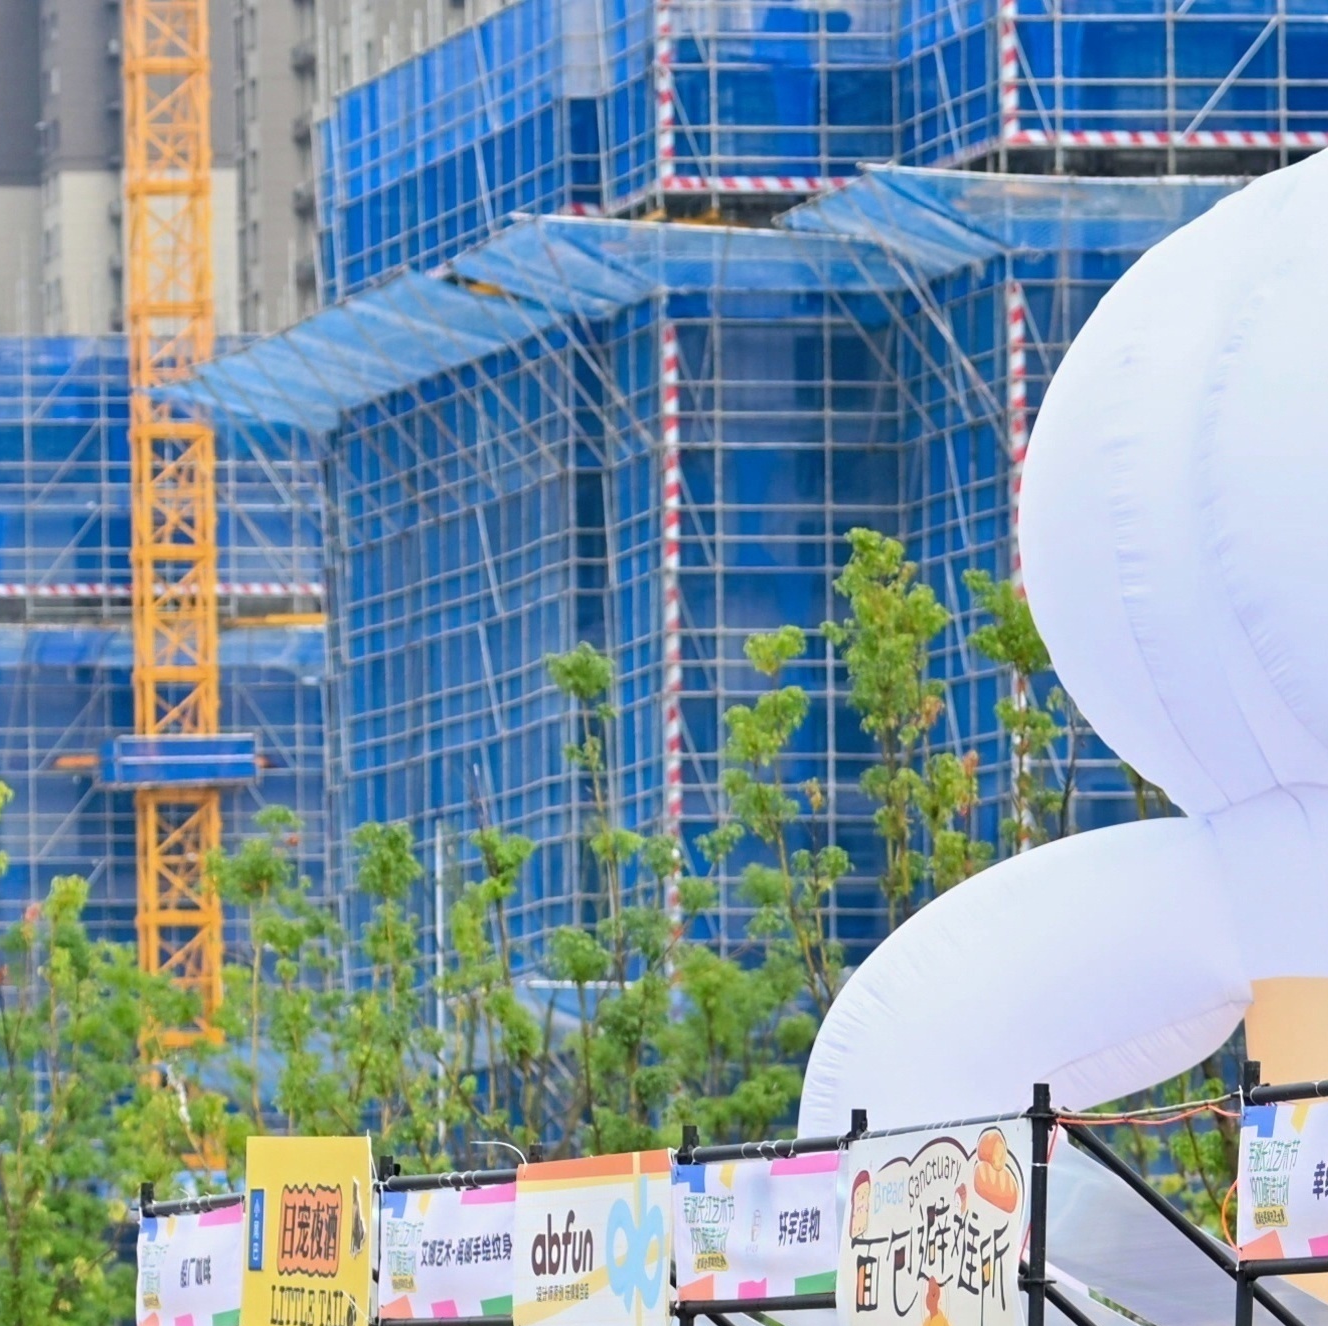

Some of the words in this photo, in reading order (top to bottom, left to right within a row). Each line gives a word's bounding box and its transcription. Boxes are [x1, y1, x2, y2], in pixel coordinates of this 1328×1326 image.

[874, 1177, 905, 1214] Bread
[908, 1155, 962, 1213] Sanctuary
[531, 1209, 594, 1277] abfun
